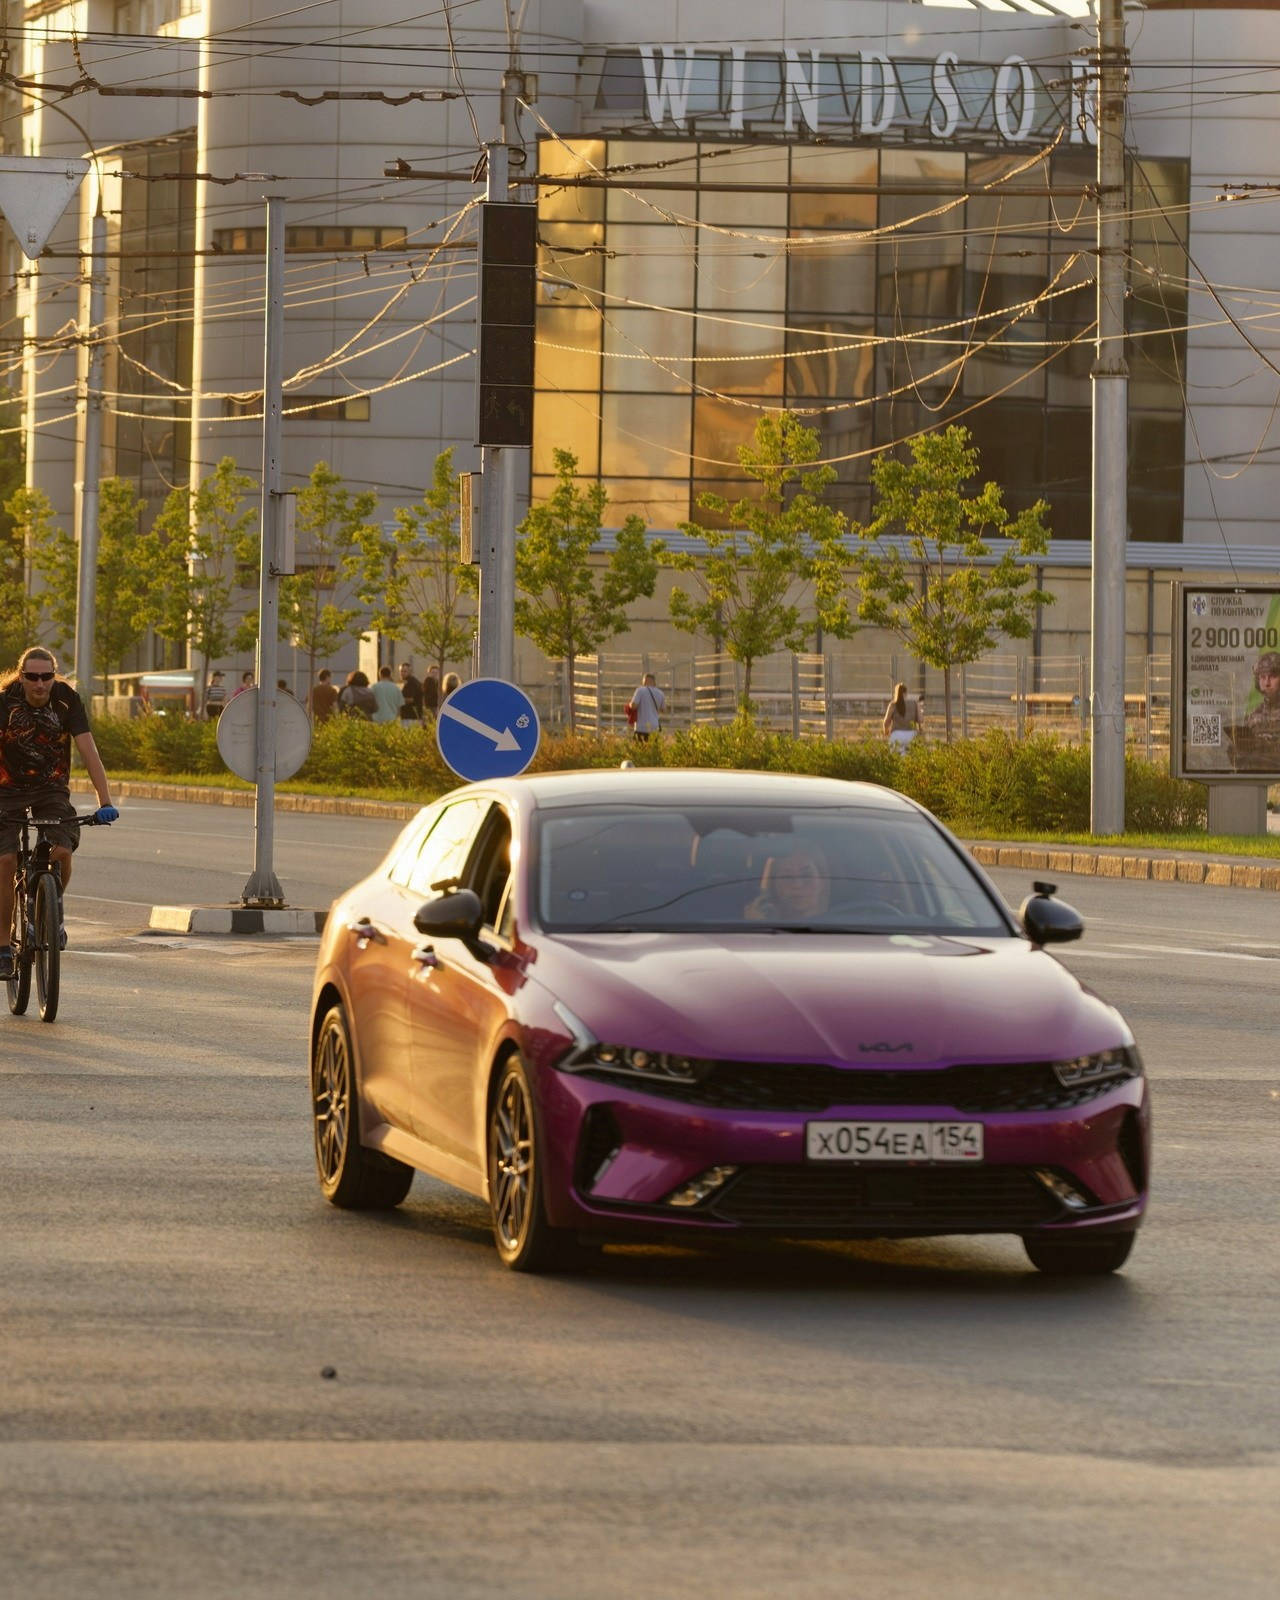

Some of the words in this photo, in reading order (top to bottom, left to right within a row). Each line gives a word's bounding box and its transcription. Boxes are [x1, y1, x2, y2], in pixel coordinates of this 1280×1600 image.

[1211, 596, 1243, 606] СЛУЖБА
[1211, 607, 1222, 616] ПО
[1223, 607, 1265, 617] КОНТРАКТУ
[1191, 627, 1202, 648] 2
[1205, 627, 1240, 648] 900
[1244, 627, 1278, 648] 000
[1202, 689, 1213, 697] 117
